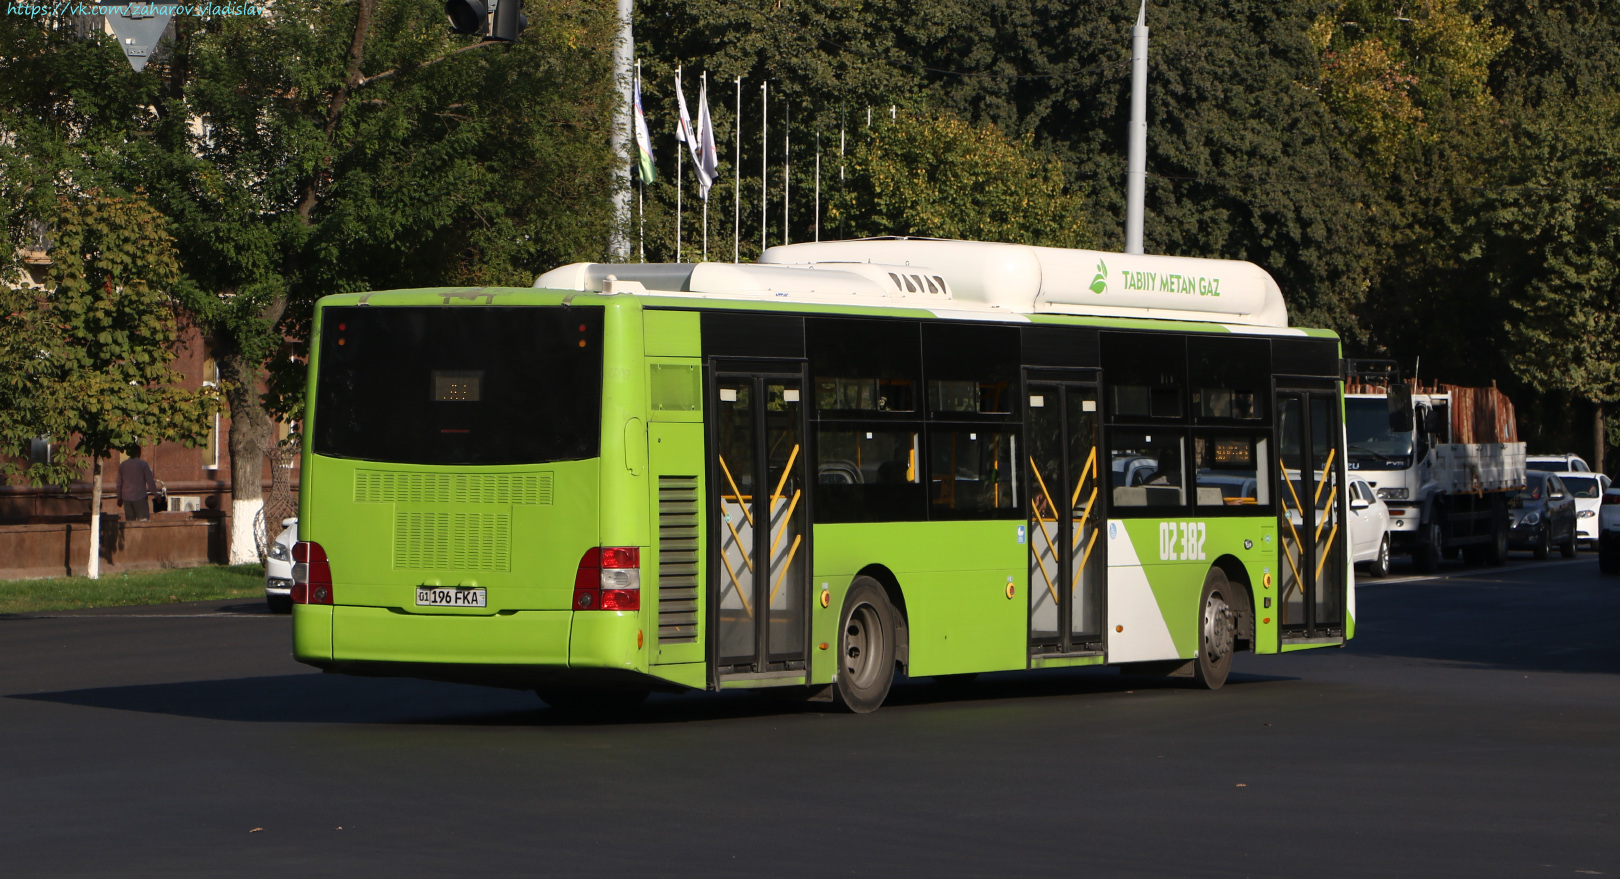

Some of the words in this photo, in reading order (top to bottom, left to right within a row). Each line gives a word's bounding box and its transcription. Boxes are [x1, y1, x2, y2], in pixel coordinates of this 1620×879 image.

[1122, 270, 1157, 292] TABIIY
[1160, 273, 1196, 295] METAN
[1199, 276, 1221, 297] GAZ
[1159, 522, 1178, 561] 02
[1179, 522, 1207, 561] 382
[419, 591, 429, 602] 01
[431, 590, 452, 604] 196
[454, 591, 479, 605] FKA
